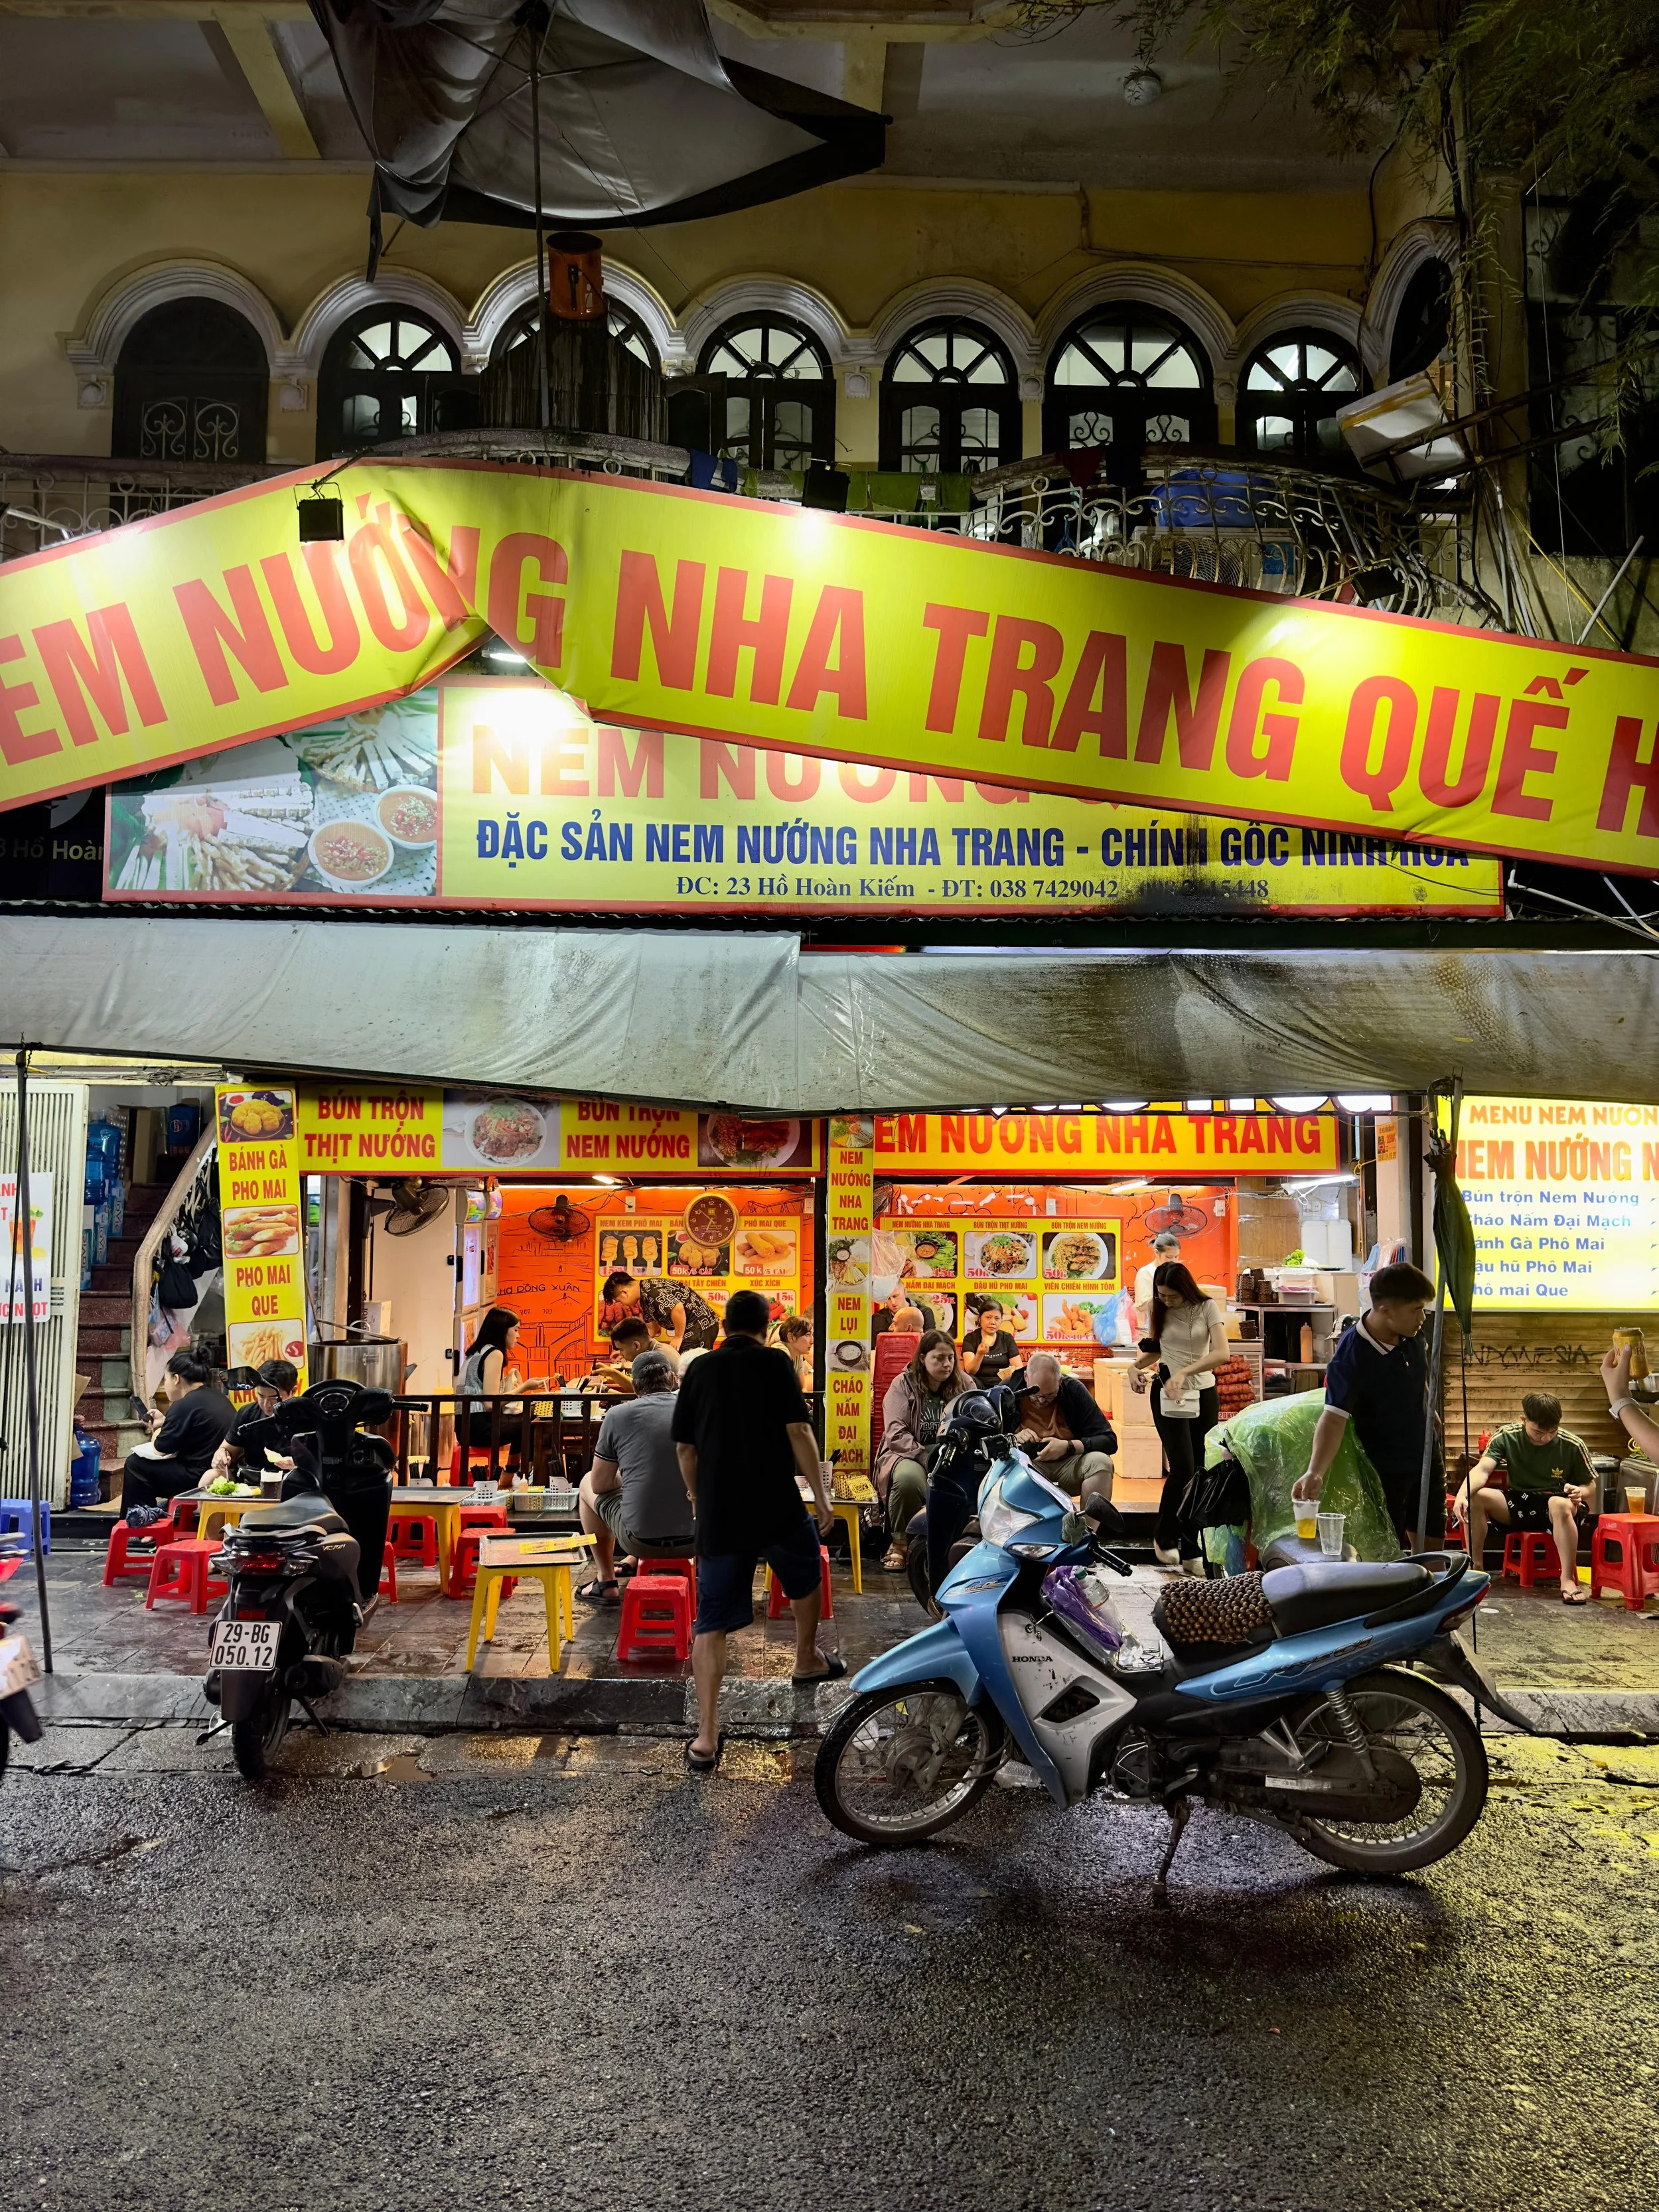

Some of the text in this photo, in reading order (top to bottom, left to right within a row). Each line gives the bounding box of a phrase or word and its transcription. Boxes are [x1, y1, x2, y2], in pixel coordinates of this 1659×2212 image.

[610, 550, 867, 720] NHA
[923, 602, 1305, 782] TRANG
[1340, 668, 1590, 821] QUẾ
[472, 724, 664, 798] NEM
[476, 812, 547, 868] ĐẶC
[561, 808, 632, 861] SẢN
[646, 824, 724, 863] NEM
[736, 817, 857, 865] NƯỚNG
[870, 826, 941, 865] NHA
[952, 828, 1064, 866] TRANG
[1102, 820, 1208, 867] CHÍNH
[1302, 828, 1387, 866] NINH
[676, 876, 719, 895] ĐC:
[727, 877, 751, 895] 23
[758, 873, 788, 896] Hồ
[796, 875, 851, 897] Hoàn
[859, 875, 914, 897] Kiếm
[942, 879, 982, 897] ĐT:
[990, 879, 1027, 898] 038
[1033, 879, 1118, 898] 7429042
[319, 1089, 425, 1126] BÚN TRỘN
[1469, 1104, 1532, 1124] MENU
[1539, 1106, 1587, 1126] NEM
[567, 1128, 690, 1159] NEM NƯỚNG
[1096, 1115, 1177, 1154] NHA
[1189, 1115, 1321, 1154] TRANG
[305, 1127, 435, 1164] THỊT NƯỚNG
[229, 1143, 287, 1171] BÁNH GÀ
[839, 1151, 863, 1165] NEM
[1526, 1132, 1632, 1181] NƯỚNG
[831, 1169, 871, 1187] NƯỚNG
[232, 1178, 287, 1201] PHO MAI
[1462, 1189, 1494, 1203] Bún
[1500, 1190, 1533, 1206] trộn
[1540, 1191, 1577, 1203] Nem
[839, 1195, 863, 1209] NHA
[831, 1217, 869, 1231] TRANG
[1469, 1212, 1631, 1230] háo Nấm Đại Mạch
[1475, 1236, 1605, 1250] ánh Gà Phô Mai
[236, 1264, 291, 1288] PHO MAI
[1475, 1260, 1592, 1275] ậu hũ Phô Mai
[693, 1278, 703, 1287] TÂY
[750, 1278, 780, 1287] XÚC XÍCH
[936, 1282, 956, 1291] MẠCH
[1473, 1283, 1569, 1297] hô mai Que
[15, 1301, 48, 1319] NỌT
[252, 1295, 279, 1317] QUE
[837, 1297, 861, 1311] NEM
[840, 1317, 858, 1335] LỤI
[833, 1376, 863, 1394] CHÁO
[836, 1396, 860, 1416] NẤM
[838, 1426, 857, 1443] ĐẠI
[223, 1623, 271, 1644] 29-BG
[214, 1646, 273, 1666] 050.12
